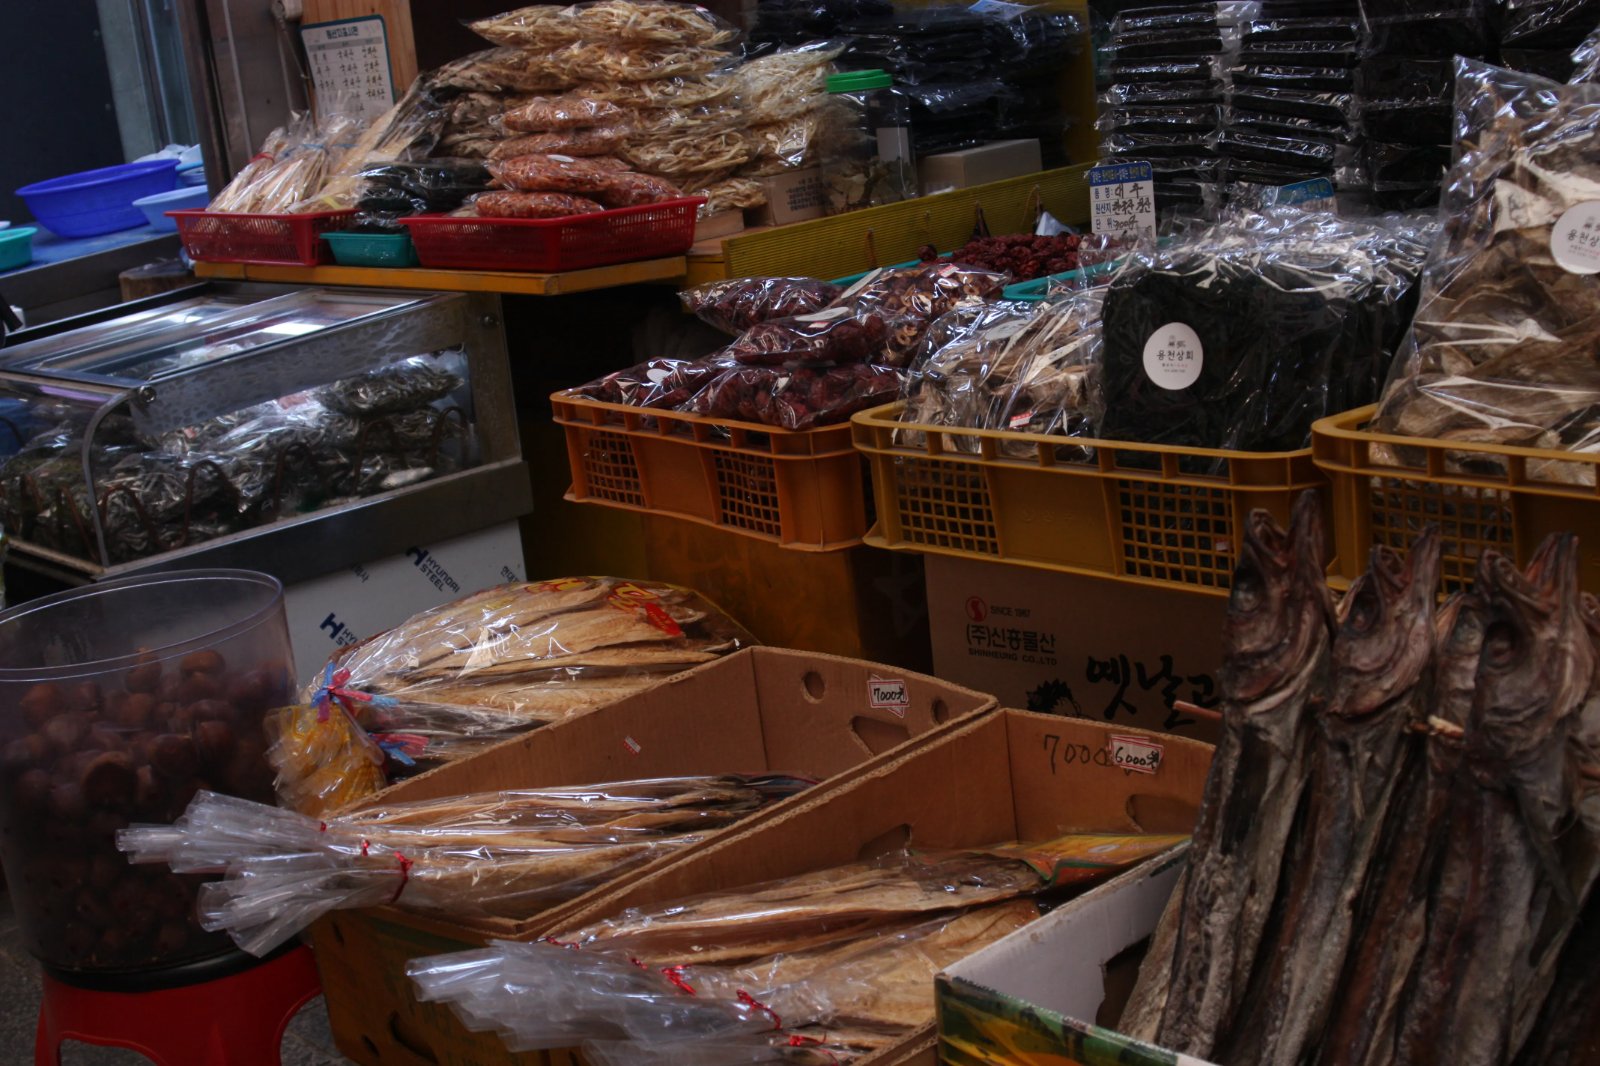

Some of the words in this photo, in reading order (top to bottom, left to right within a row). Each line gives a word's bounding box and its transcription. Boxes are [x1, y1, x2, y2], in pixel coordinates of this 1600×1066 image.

[419, 563, 445, 592] STEEL
[990, 605, 1013, 616] SINCE
[966, 624, 1057, 655] (주)신흥물산
[968, 648, 1018, 661] SHINHEUNG
